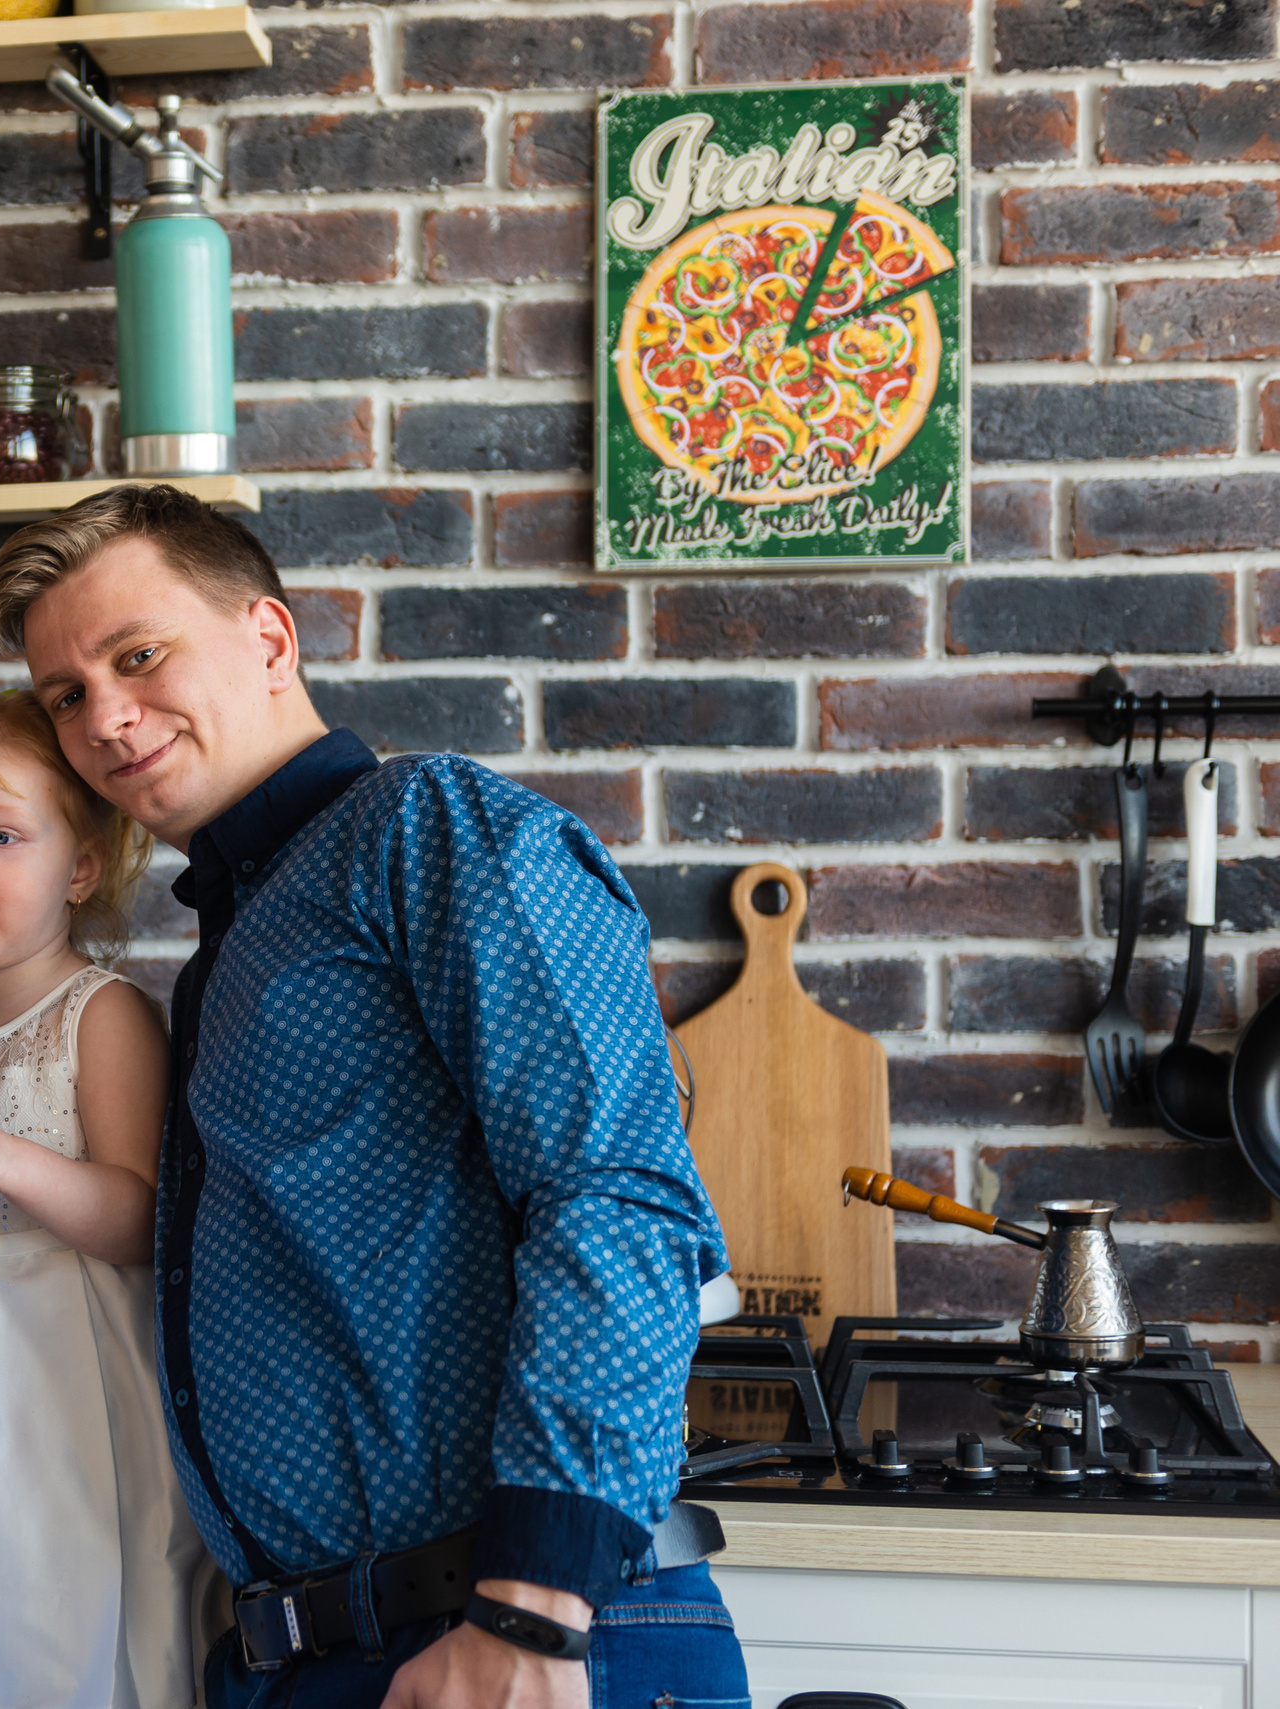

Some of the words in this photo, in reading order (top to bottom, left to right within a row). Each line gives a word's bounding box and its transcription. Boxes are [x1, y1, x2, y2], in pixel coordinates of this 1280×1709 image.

[608, 112, 956, 250] Italian
[624, 503, 734, 554] Made
[734, 495, 837, 546] Fresh
[837, 480, 953, 545] Daily!
[651, 464, 710, 519] By
[710, 456, 770, 499] The
[777, 444, 884, 491] Slice!
